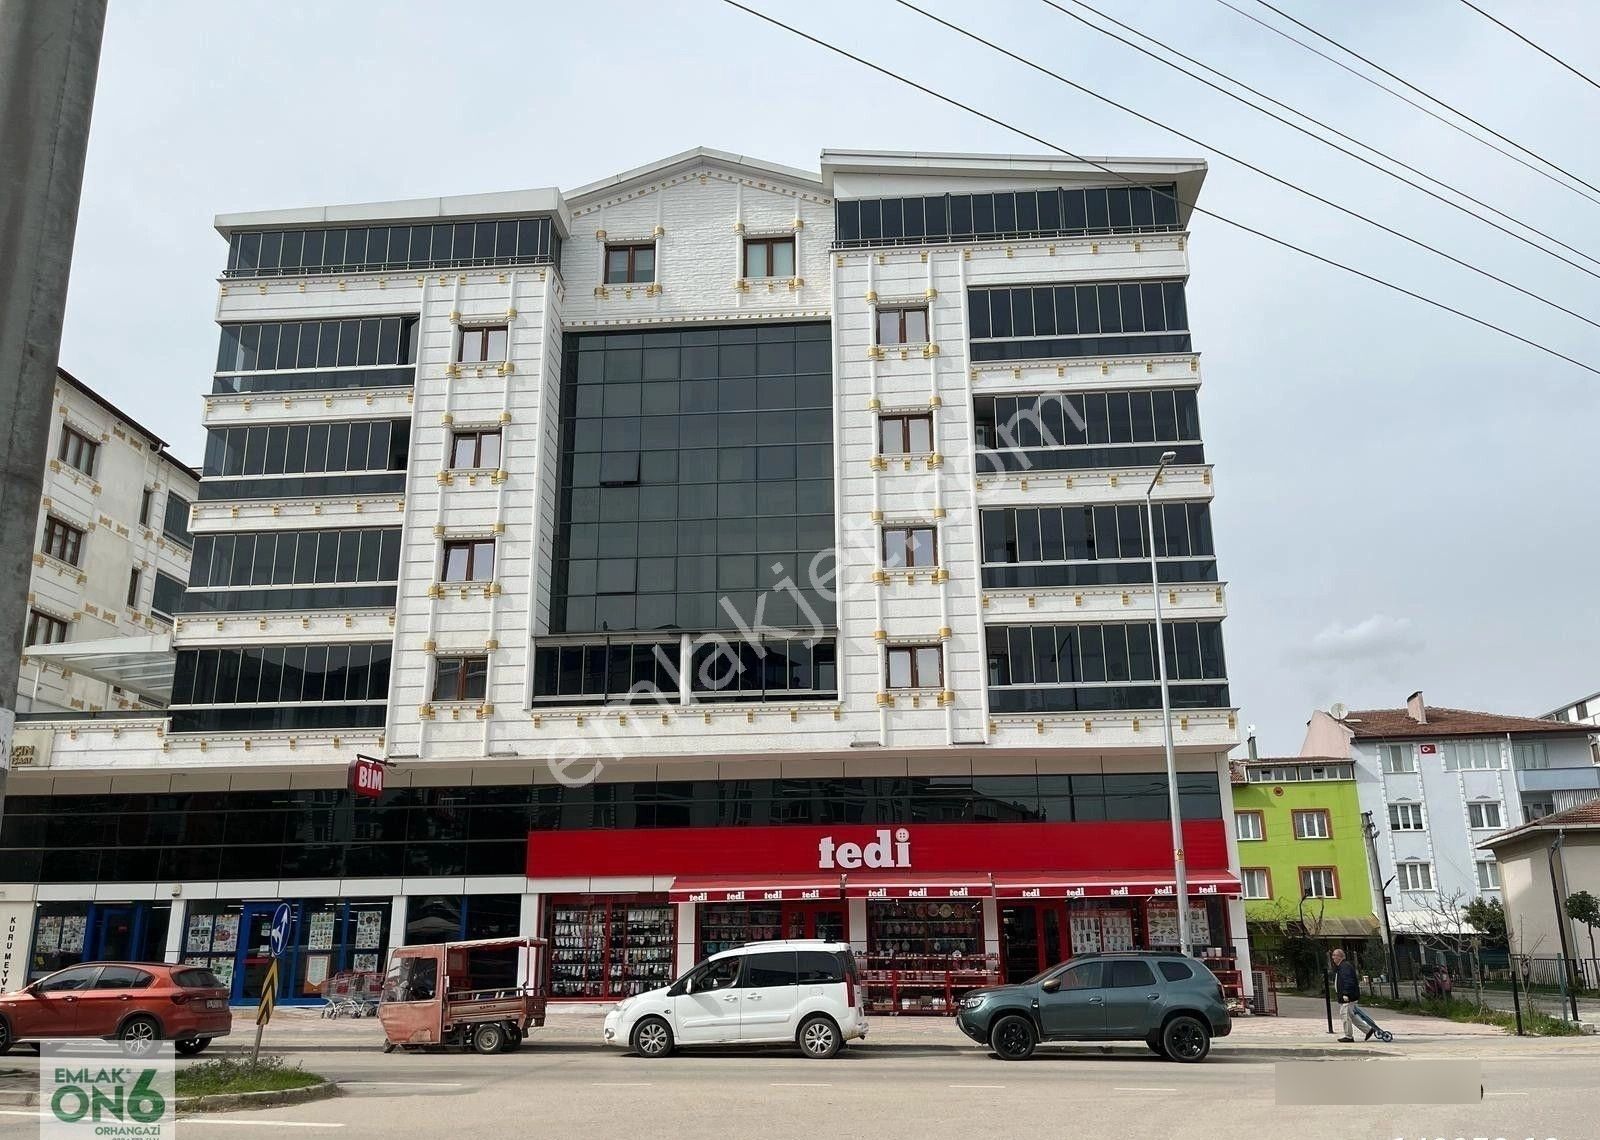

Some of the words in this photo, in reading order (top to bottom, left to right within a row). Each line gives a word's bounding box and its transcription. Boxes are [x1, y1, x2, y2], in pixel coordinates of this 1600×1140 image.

[358, 764, 383, 791] BİM
[819, 828, 912, 869] tedi
[689, 892, 708, 902] tedi
[726, 891, 745, 900] tedi
[764, 890, 782, 900] tedi
[801, 889, 820, 899] tedi
[868, 888, 887, 897] tedi
[908, 887, 928, 897] tedi
[949, 887, 968, 897] tedi
[1022, 888, 1040, 897] tedi
[1066, 887, 1085, 896] tedi
[1110, 886, 1129, 895] tedi
[1154, 885, 1173, 895] tedi
[1199, 884, 1217, 894] tedi
